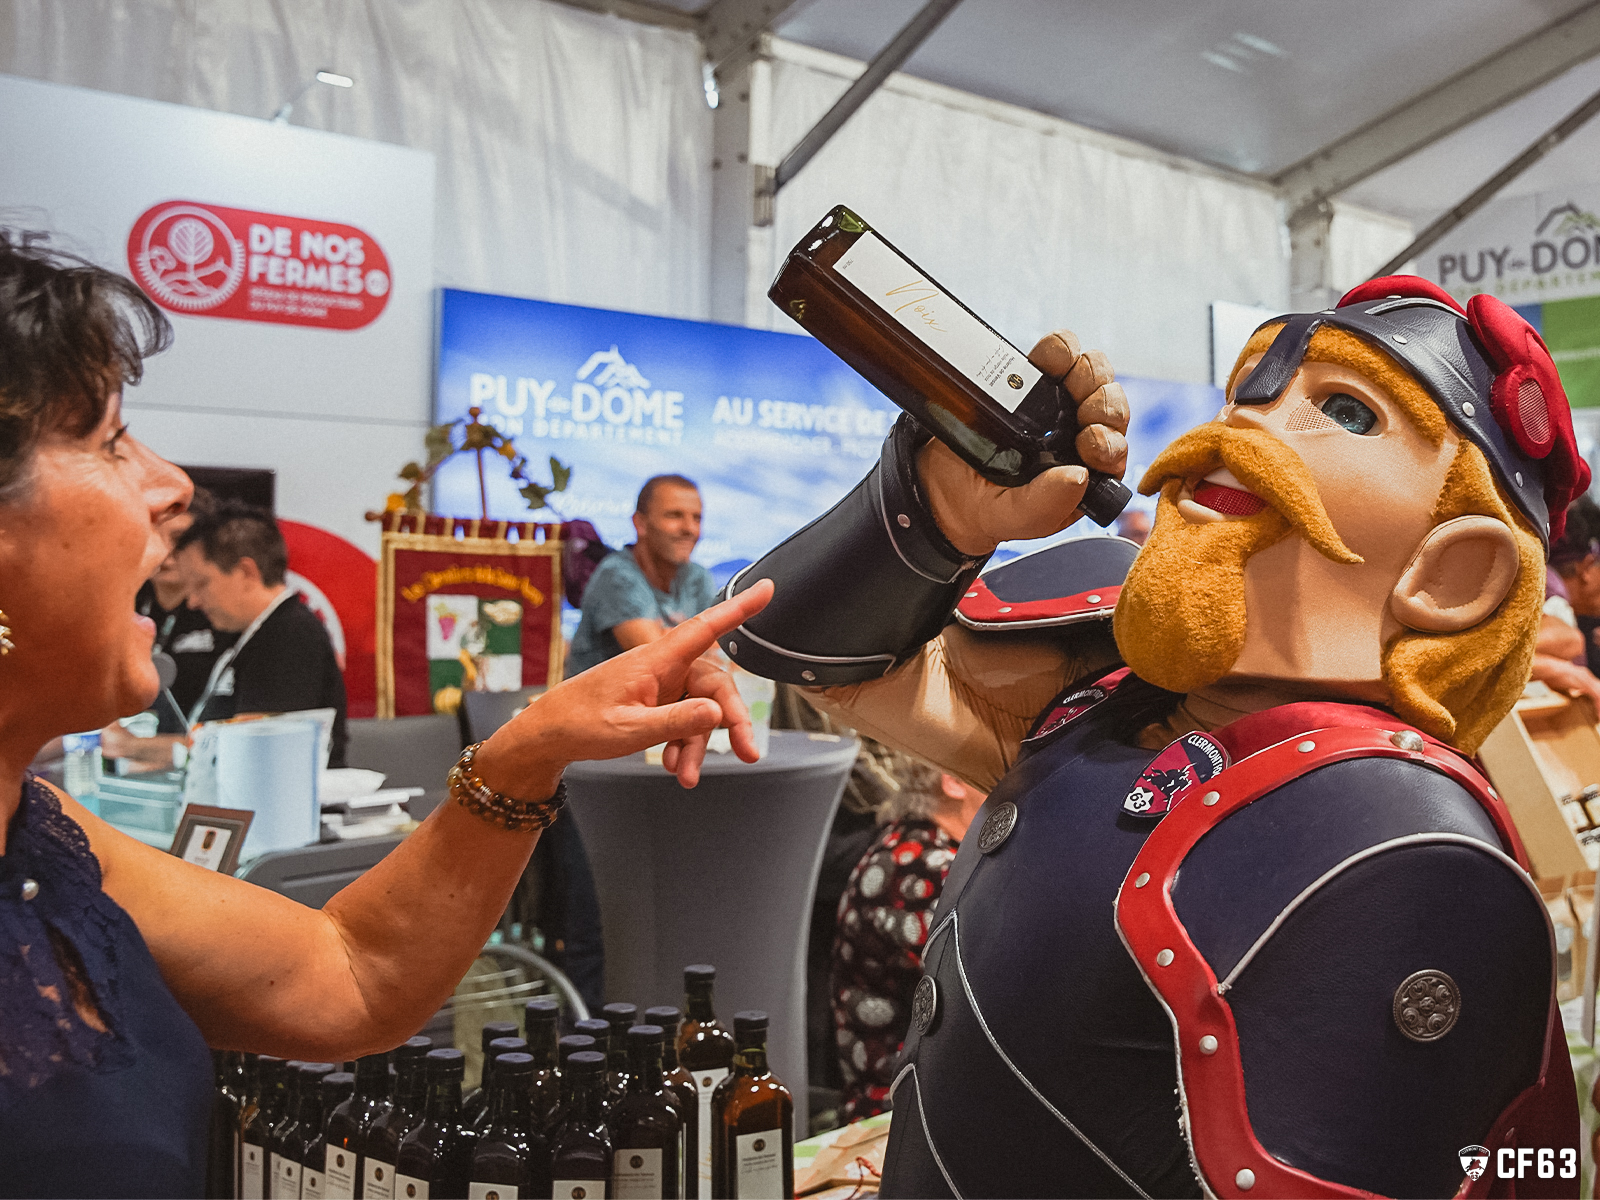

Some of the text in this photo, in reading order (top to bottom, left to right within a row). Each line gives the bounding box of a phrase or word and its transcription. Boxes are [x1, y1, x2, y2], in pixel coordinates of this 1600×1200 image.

[249, 224, 365, 265] DE NOS
[249, 254, 364, 294] FERMES
[885, 280, 947, 332] Noix
[711, 395, 888, 436] AU SERVICE DE
[1187, 734, 1223, 767] CLERMONT
[1129, 792, 1146, 810] 63
